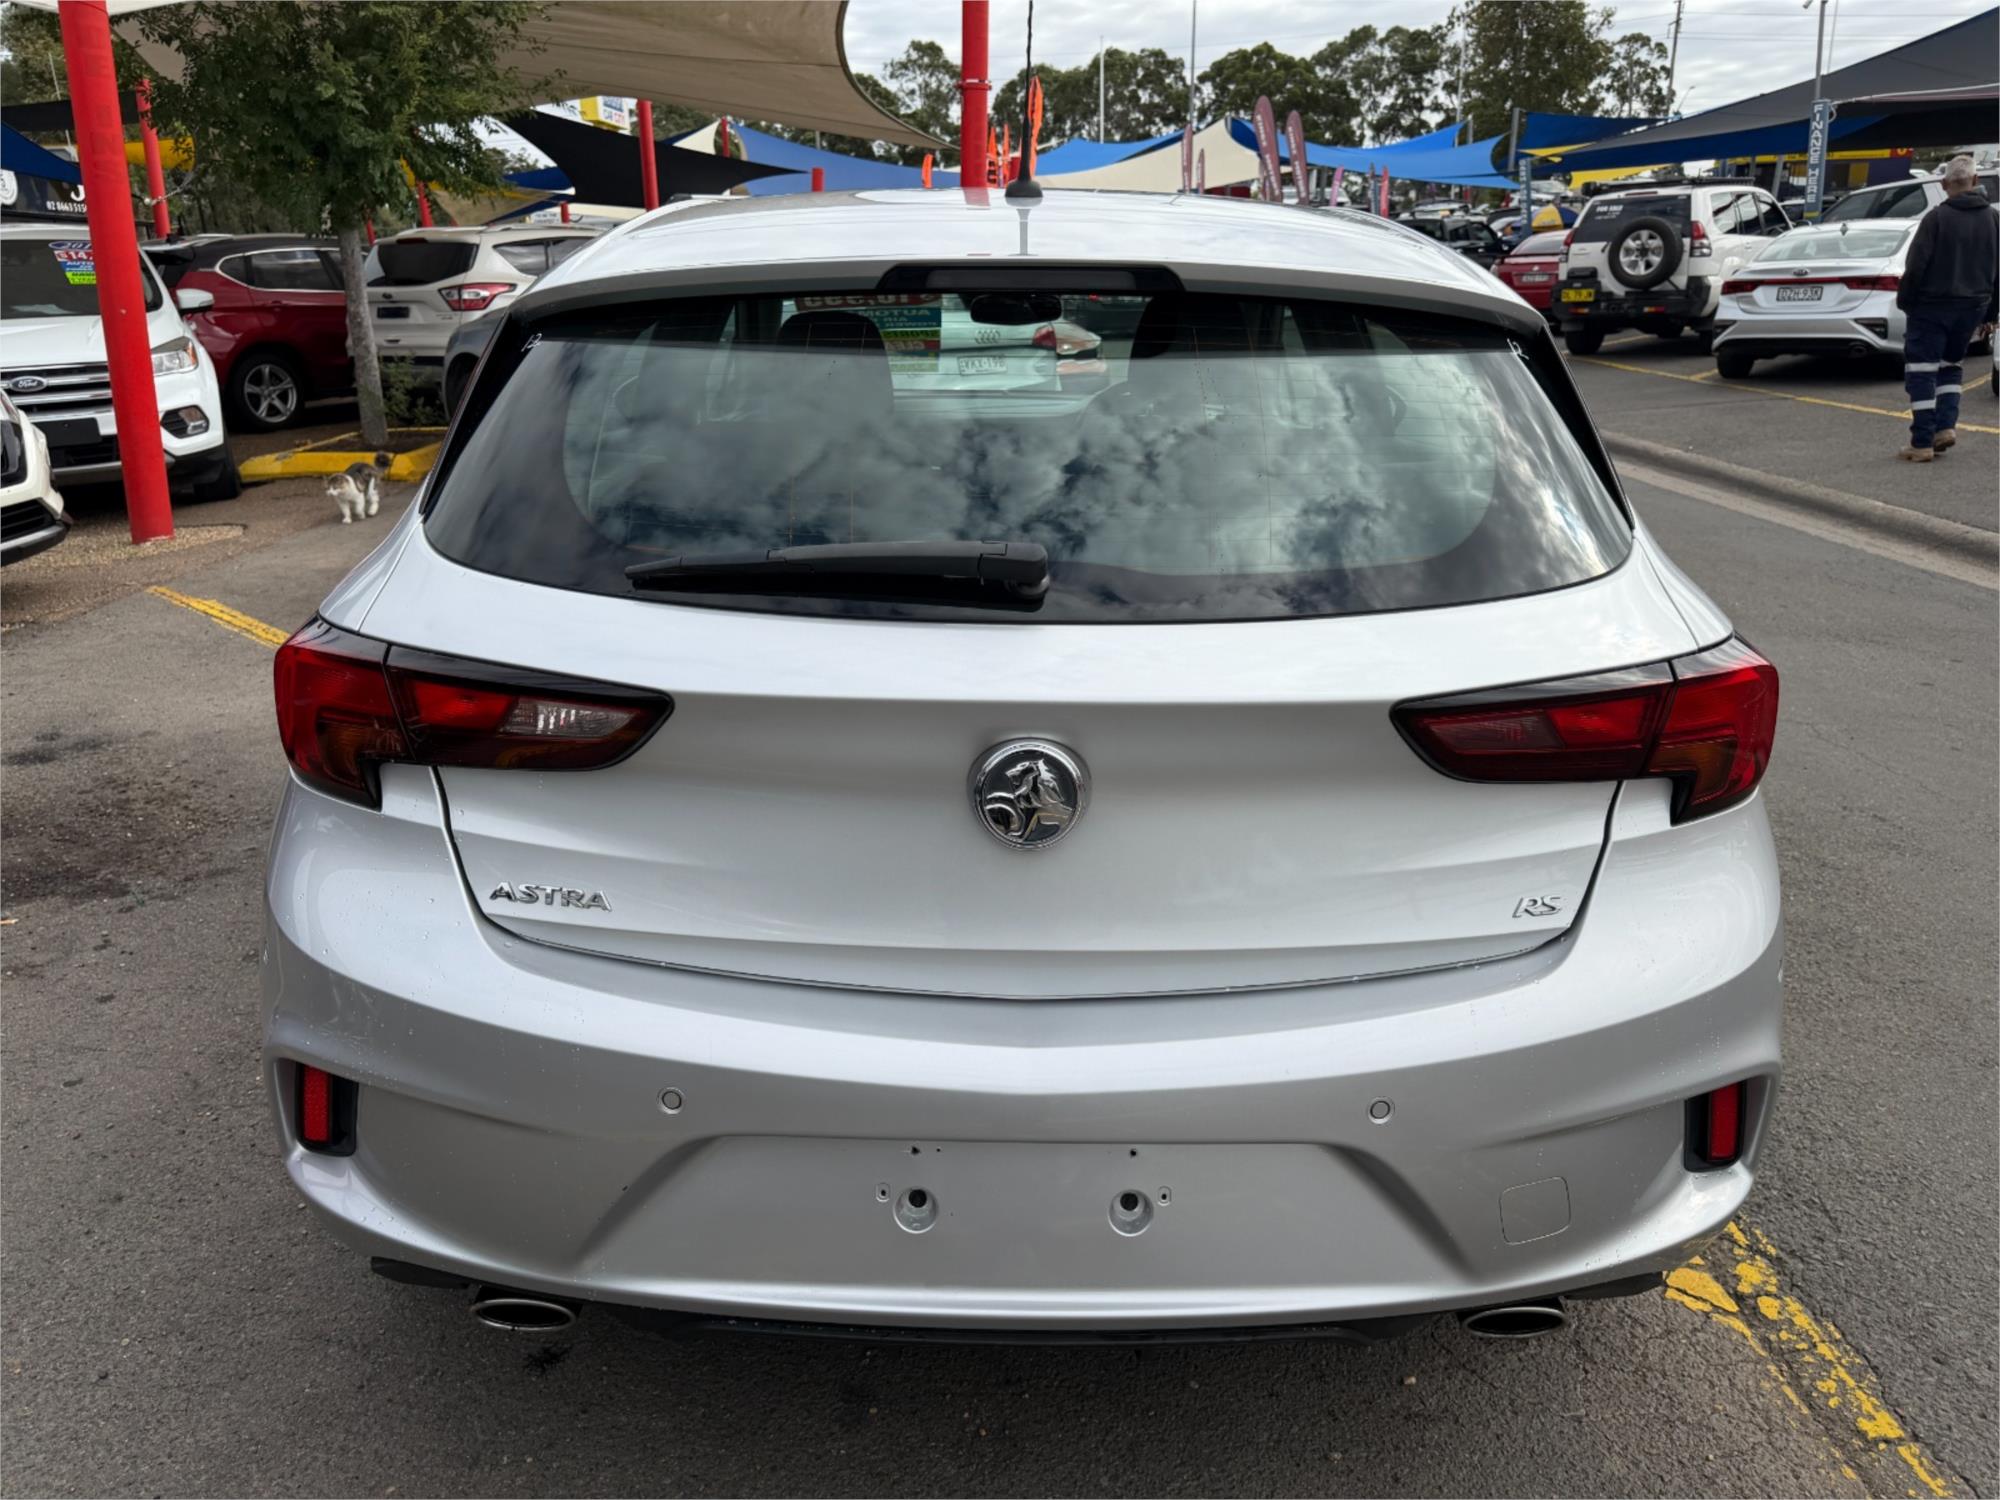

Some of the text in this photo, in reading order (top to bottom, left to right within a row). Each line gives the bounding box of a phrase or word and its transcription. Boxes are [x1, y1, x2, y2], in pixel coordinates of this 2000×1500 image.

[1806, 104, 1824, 203] FINANCE HERE
[490, 881, 612, 912] ASTRA
[1512, 896, 1562, 918] RS
